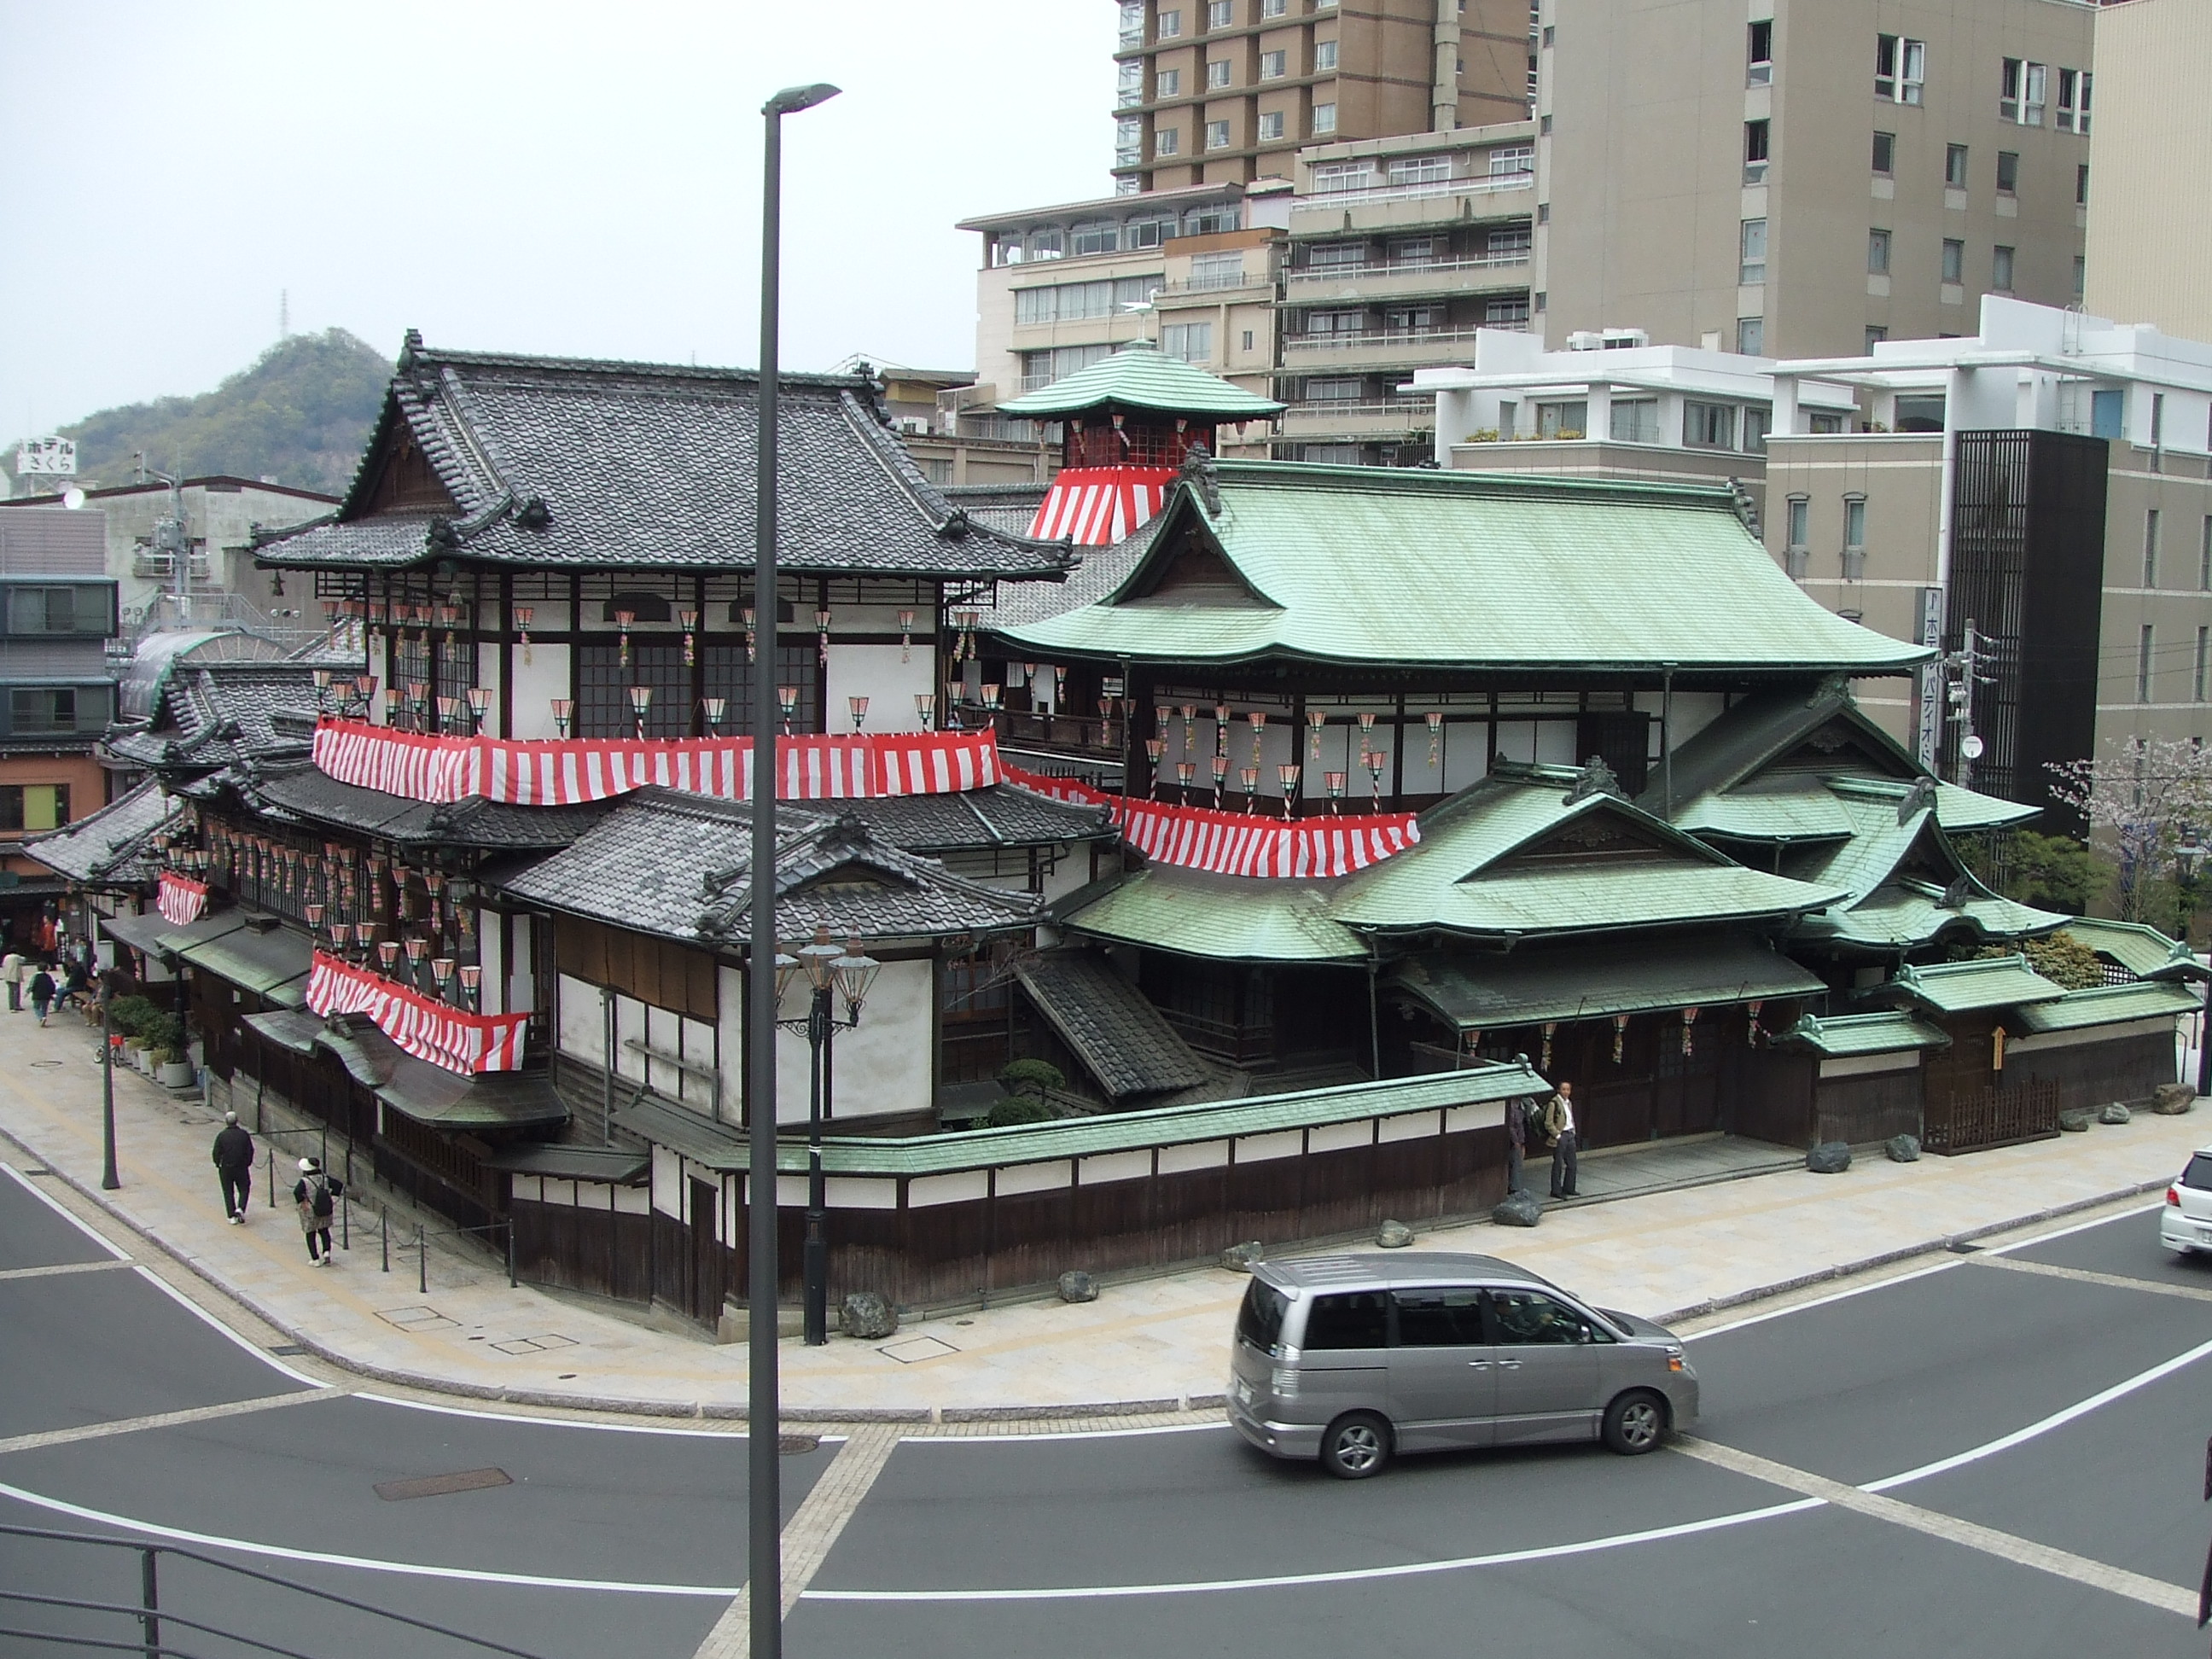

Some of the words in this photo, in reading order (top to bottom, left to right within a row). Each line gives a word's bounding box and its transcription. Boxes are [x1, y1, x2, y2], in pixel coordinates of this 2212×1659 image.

[27, 437, 73, 454] ホテル
[30, 456, 70, 471] さくら
